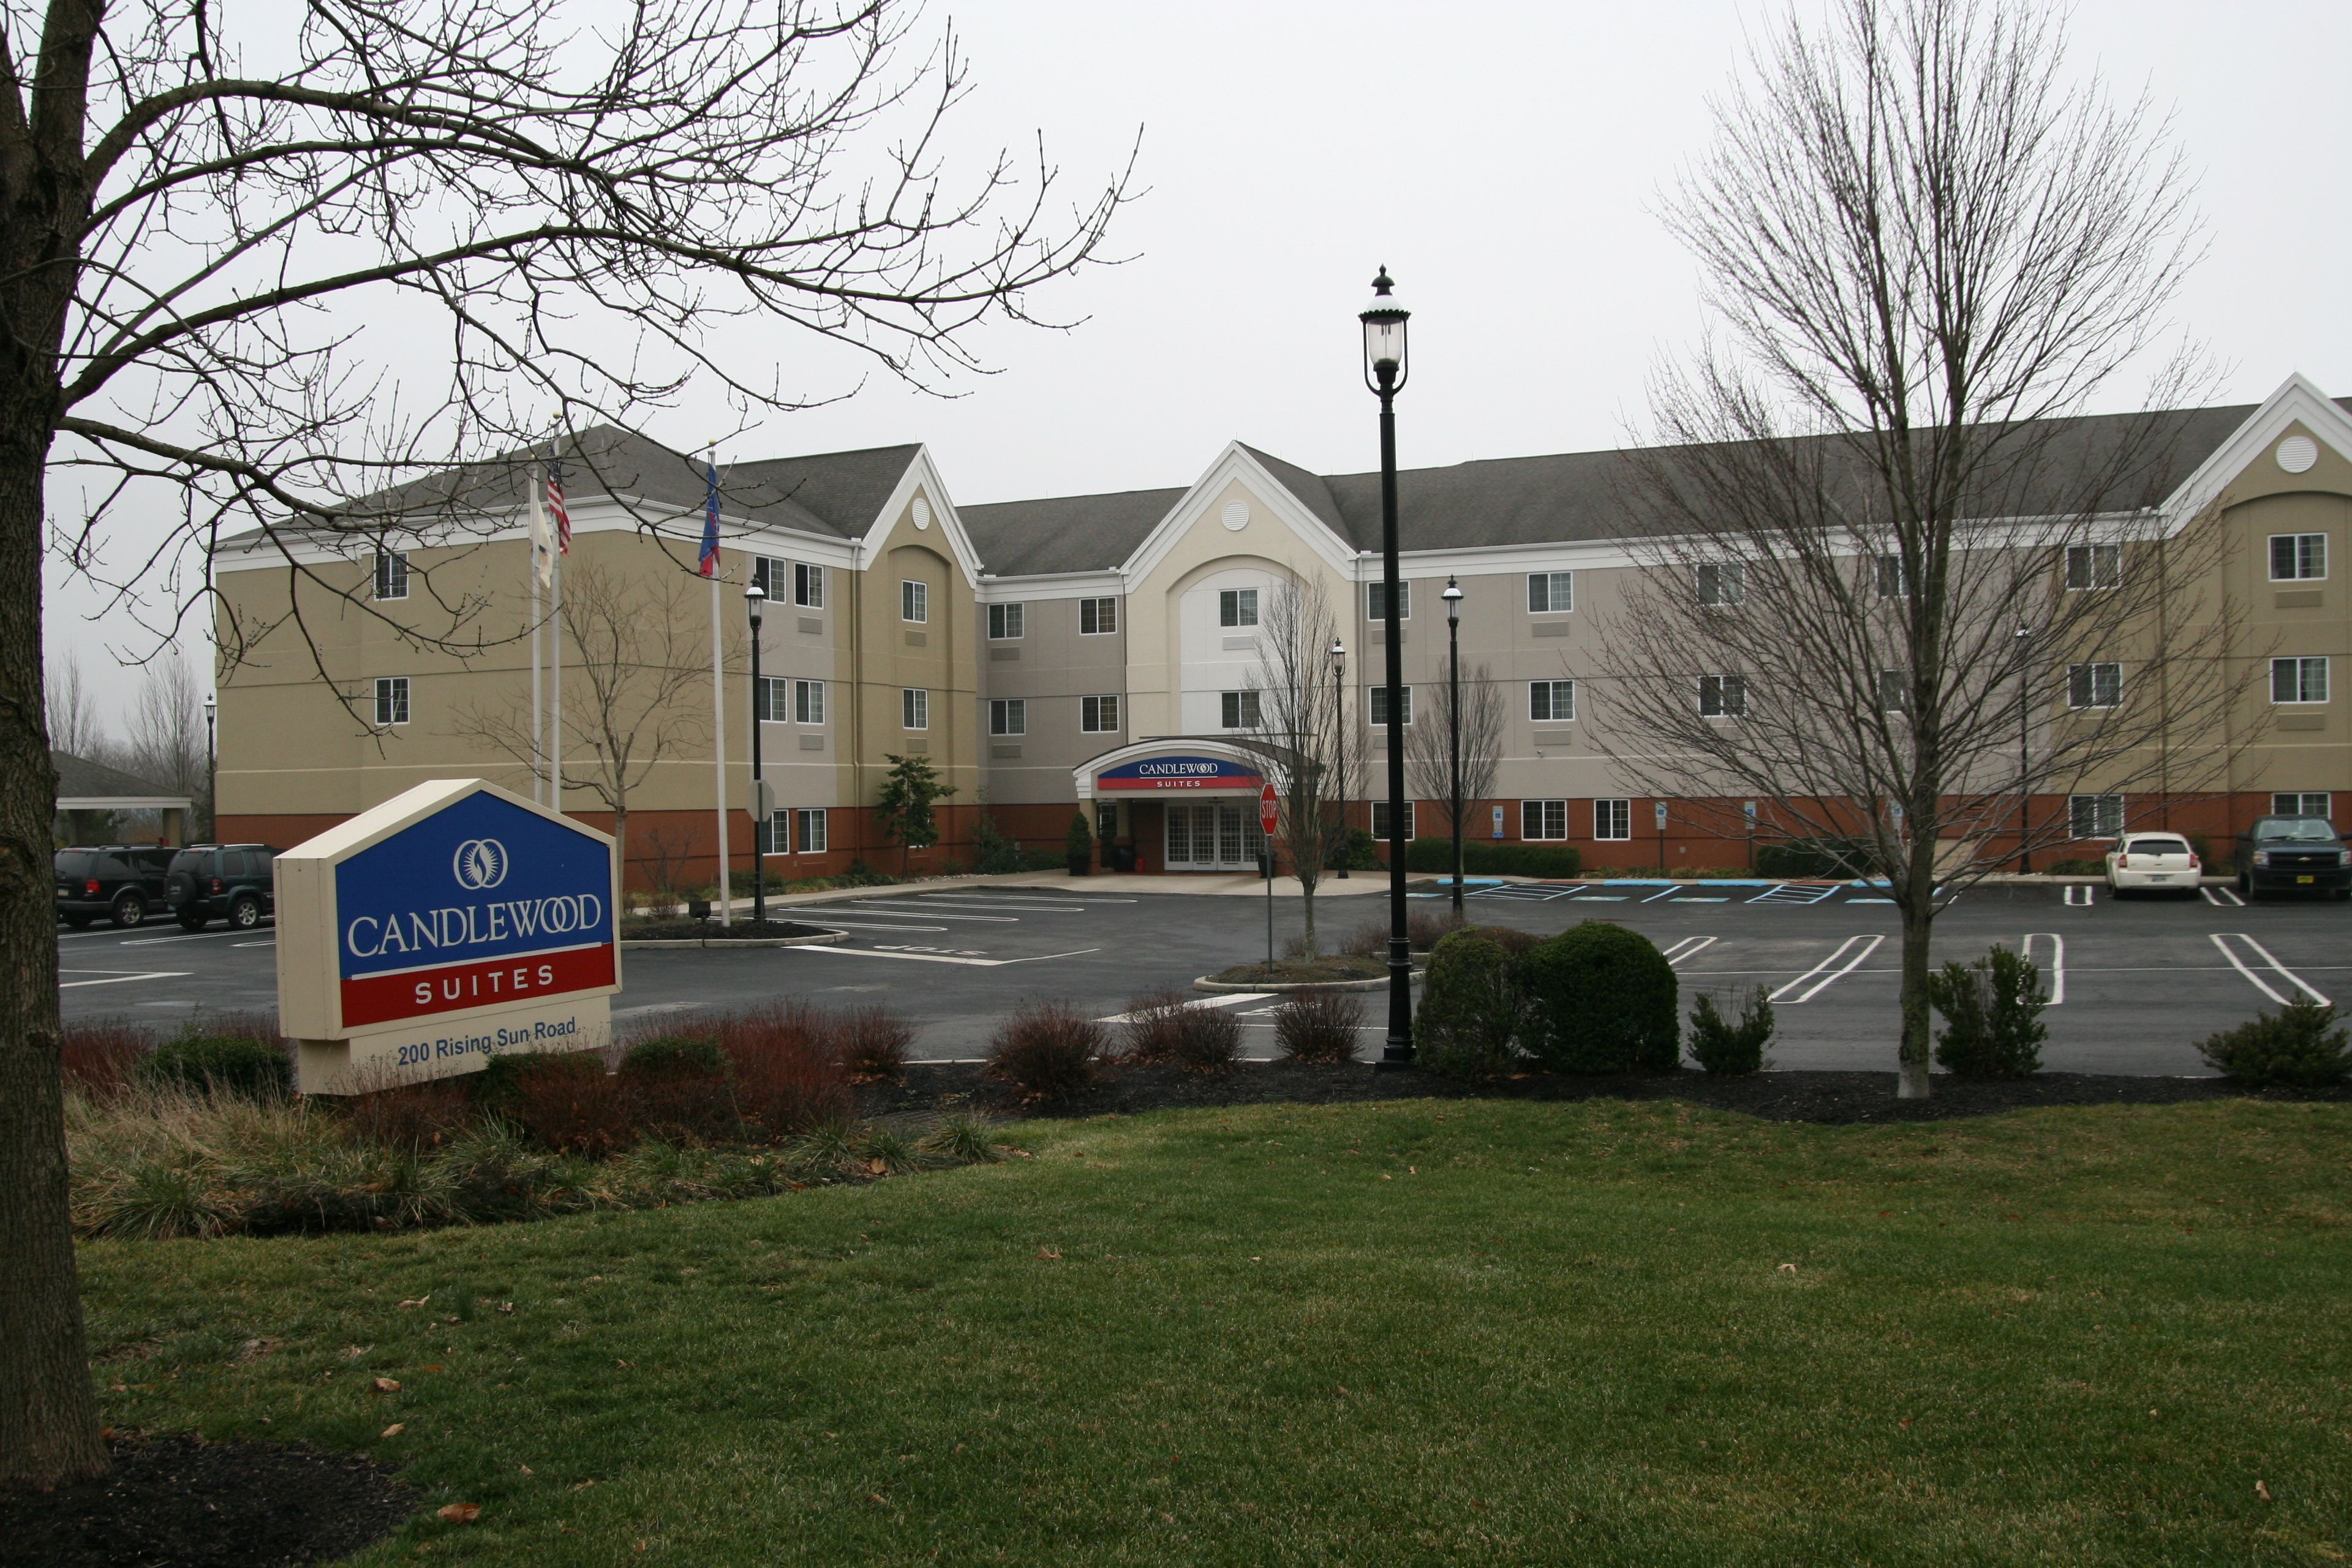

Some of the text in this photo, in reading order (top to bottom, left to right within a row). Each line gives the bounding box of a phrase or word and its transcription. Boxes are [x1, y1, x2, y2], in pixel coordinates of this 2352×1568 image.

[1139, 763, 1218, 775] CANDLEWOOD
[1262, 800, 1277, 819] STOP
[347, 893, 601, 958] CANDLEWOOD
[415, 965, 554, 1005] SUITES
[398, 1016, 576, 1066] 200 Rising Sun Road
